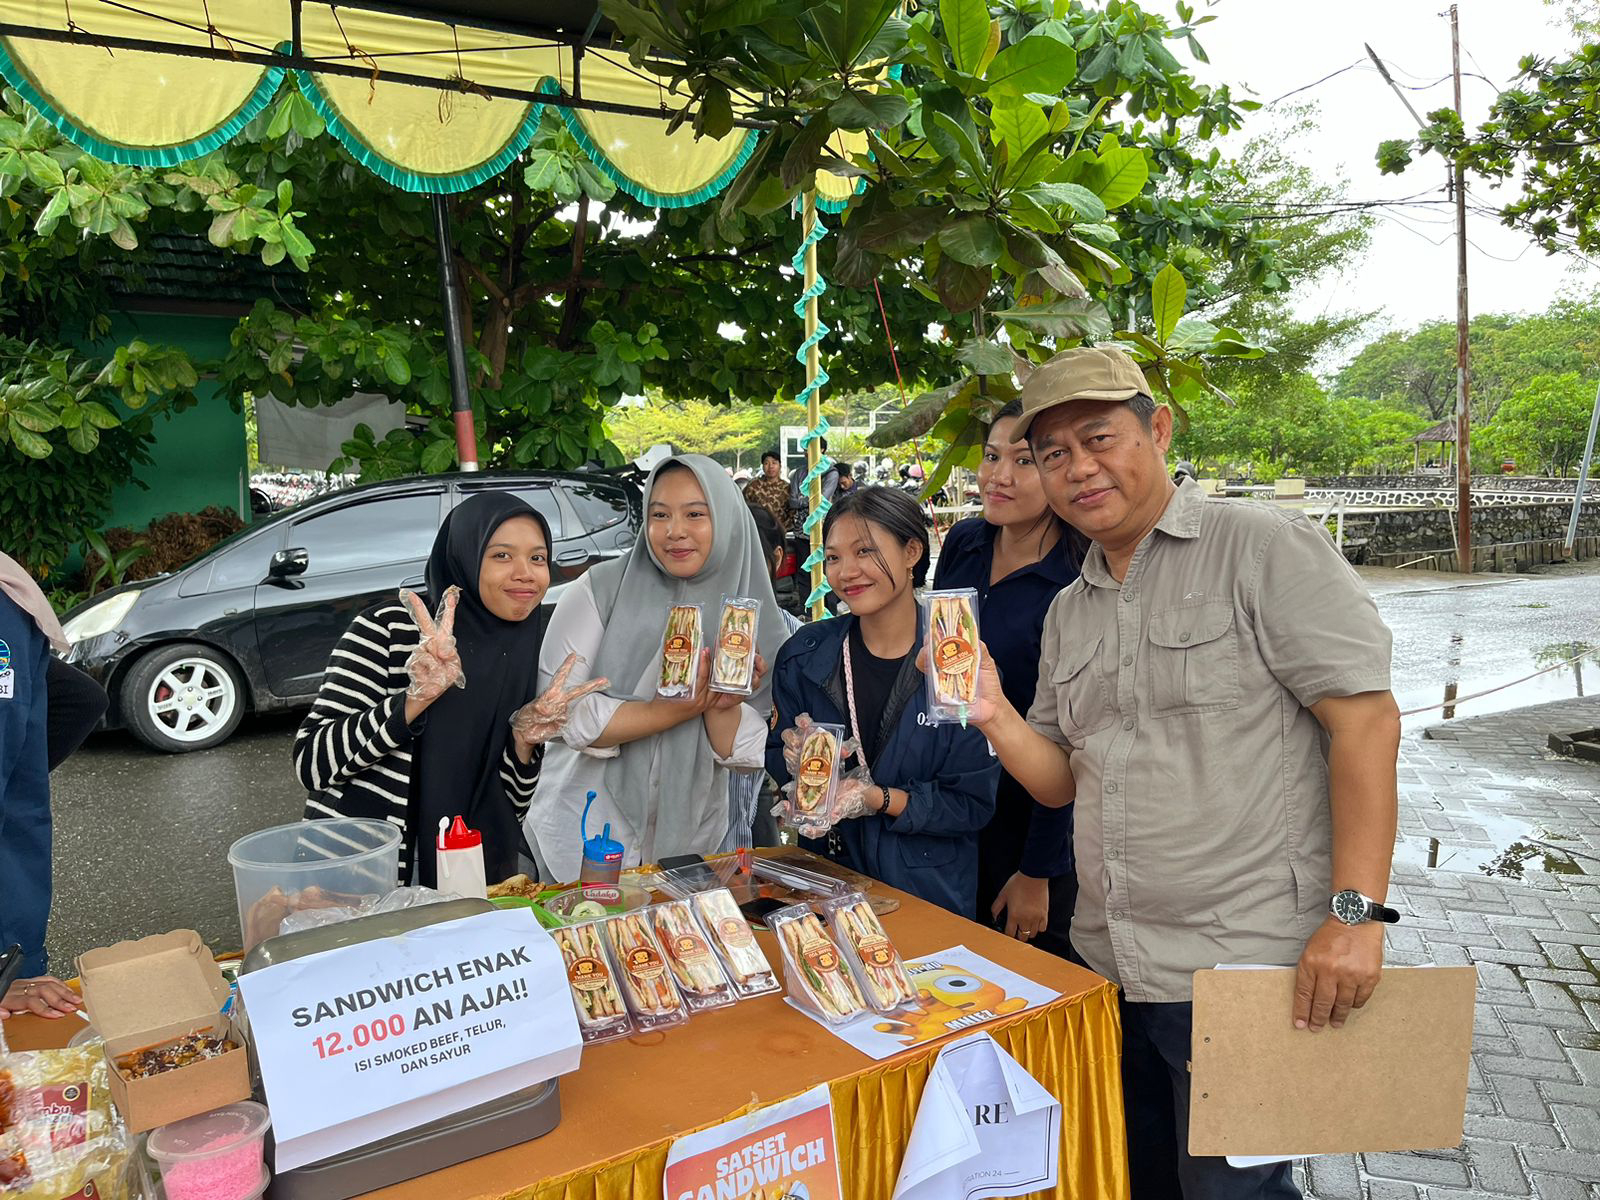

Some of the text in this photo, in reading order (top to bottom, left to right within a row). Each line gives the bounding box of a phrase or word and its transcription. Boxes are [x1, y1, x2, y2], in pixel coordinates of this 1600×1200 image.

[291, 945, 532, 1028] SANDWICH ENAK
[312, 978, 528, 1059] 12.000 AN AJA!!
[354, 1018, 506, 1073] ISI SMOKED BEEF, TELUR,
[401, 1044, 471, 1074] DAN SAYUR
[715, 1131, 787, 1179] SATSET
